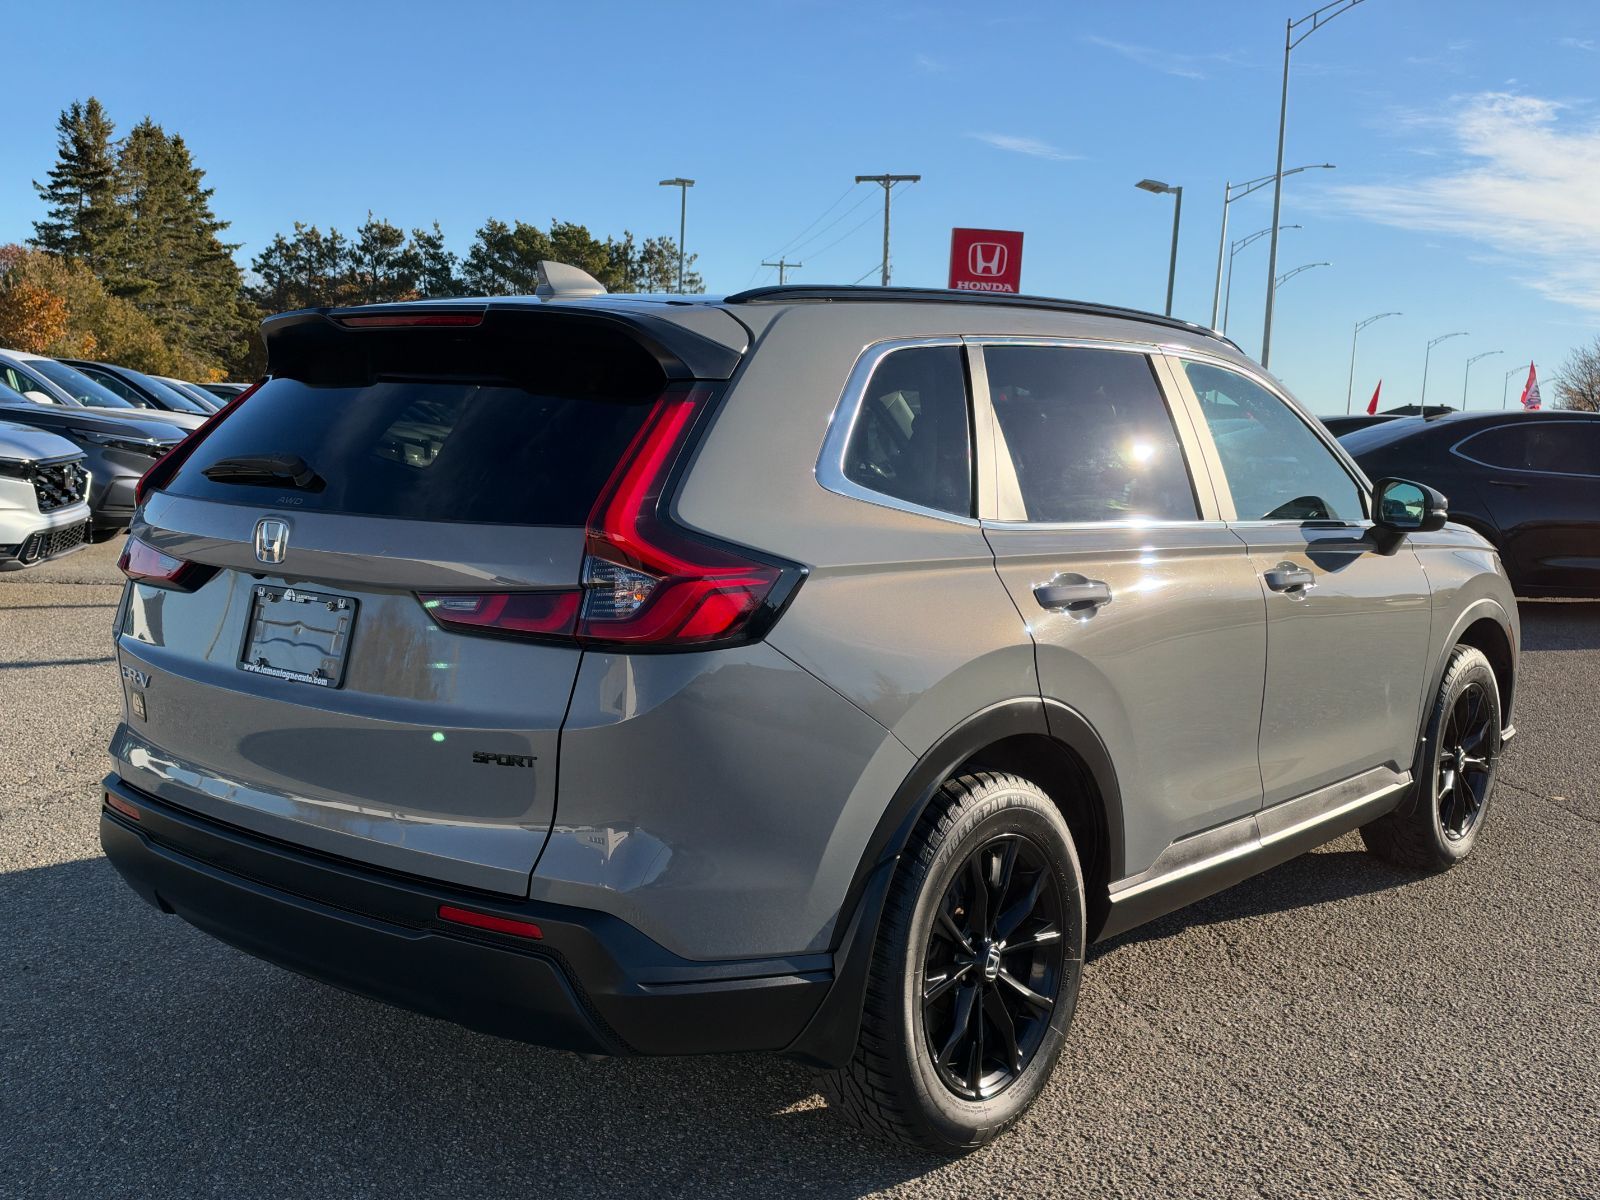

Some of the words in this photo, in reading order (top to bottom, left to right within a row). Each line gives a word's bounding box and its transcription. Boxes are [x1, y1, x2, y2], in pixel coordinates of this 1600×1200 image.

[957, 281, 1014, 292] HONDA
[276, 496, 303, 505] AWD
[244, 663, 328, 686] www.lamontagneauto.com
[473, 751, 538, 768] SPORT
[982, 796, 1008, 818] PAW
